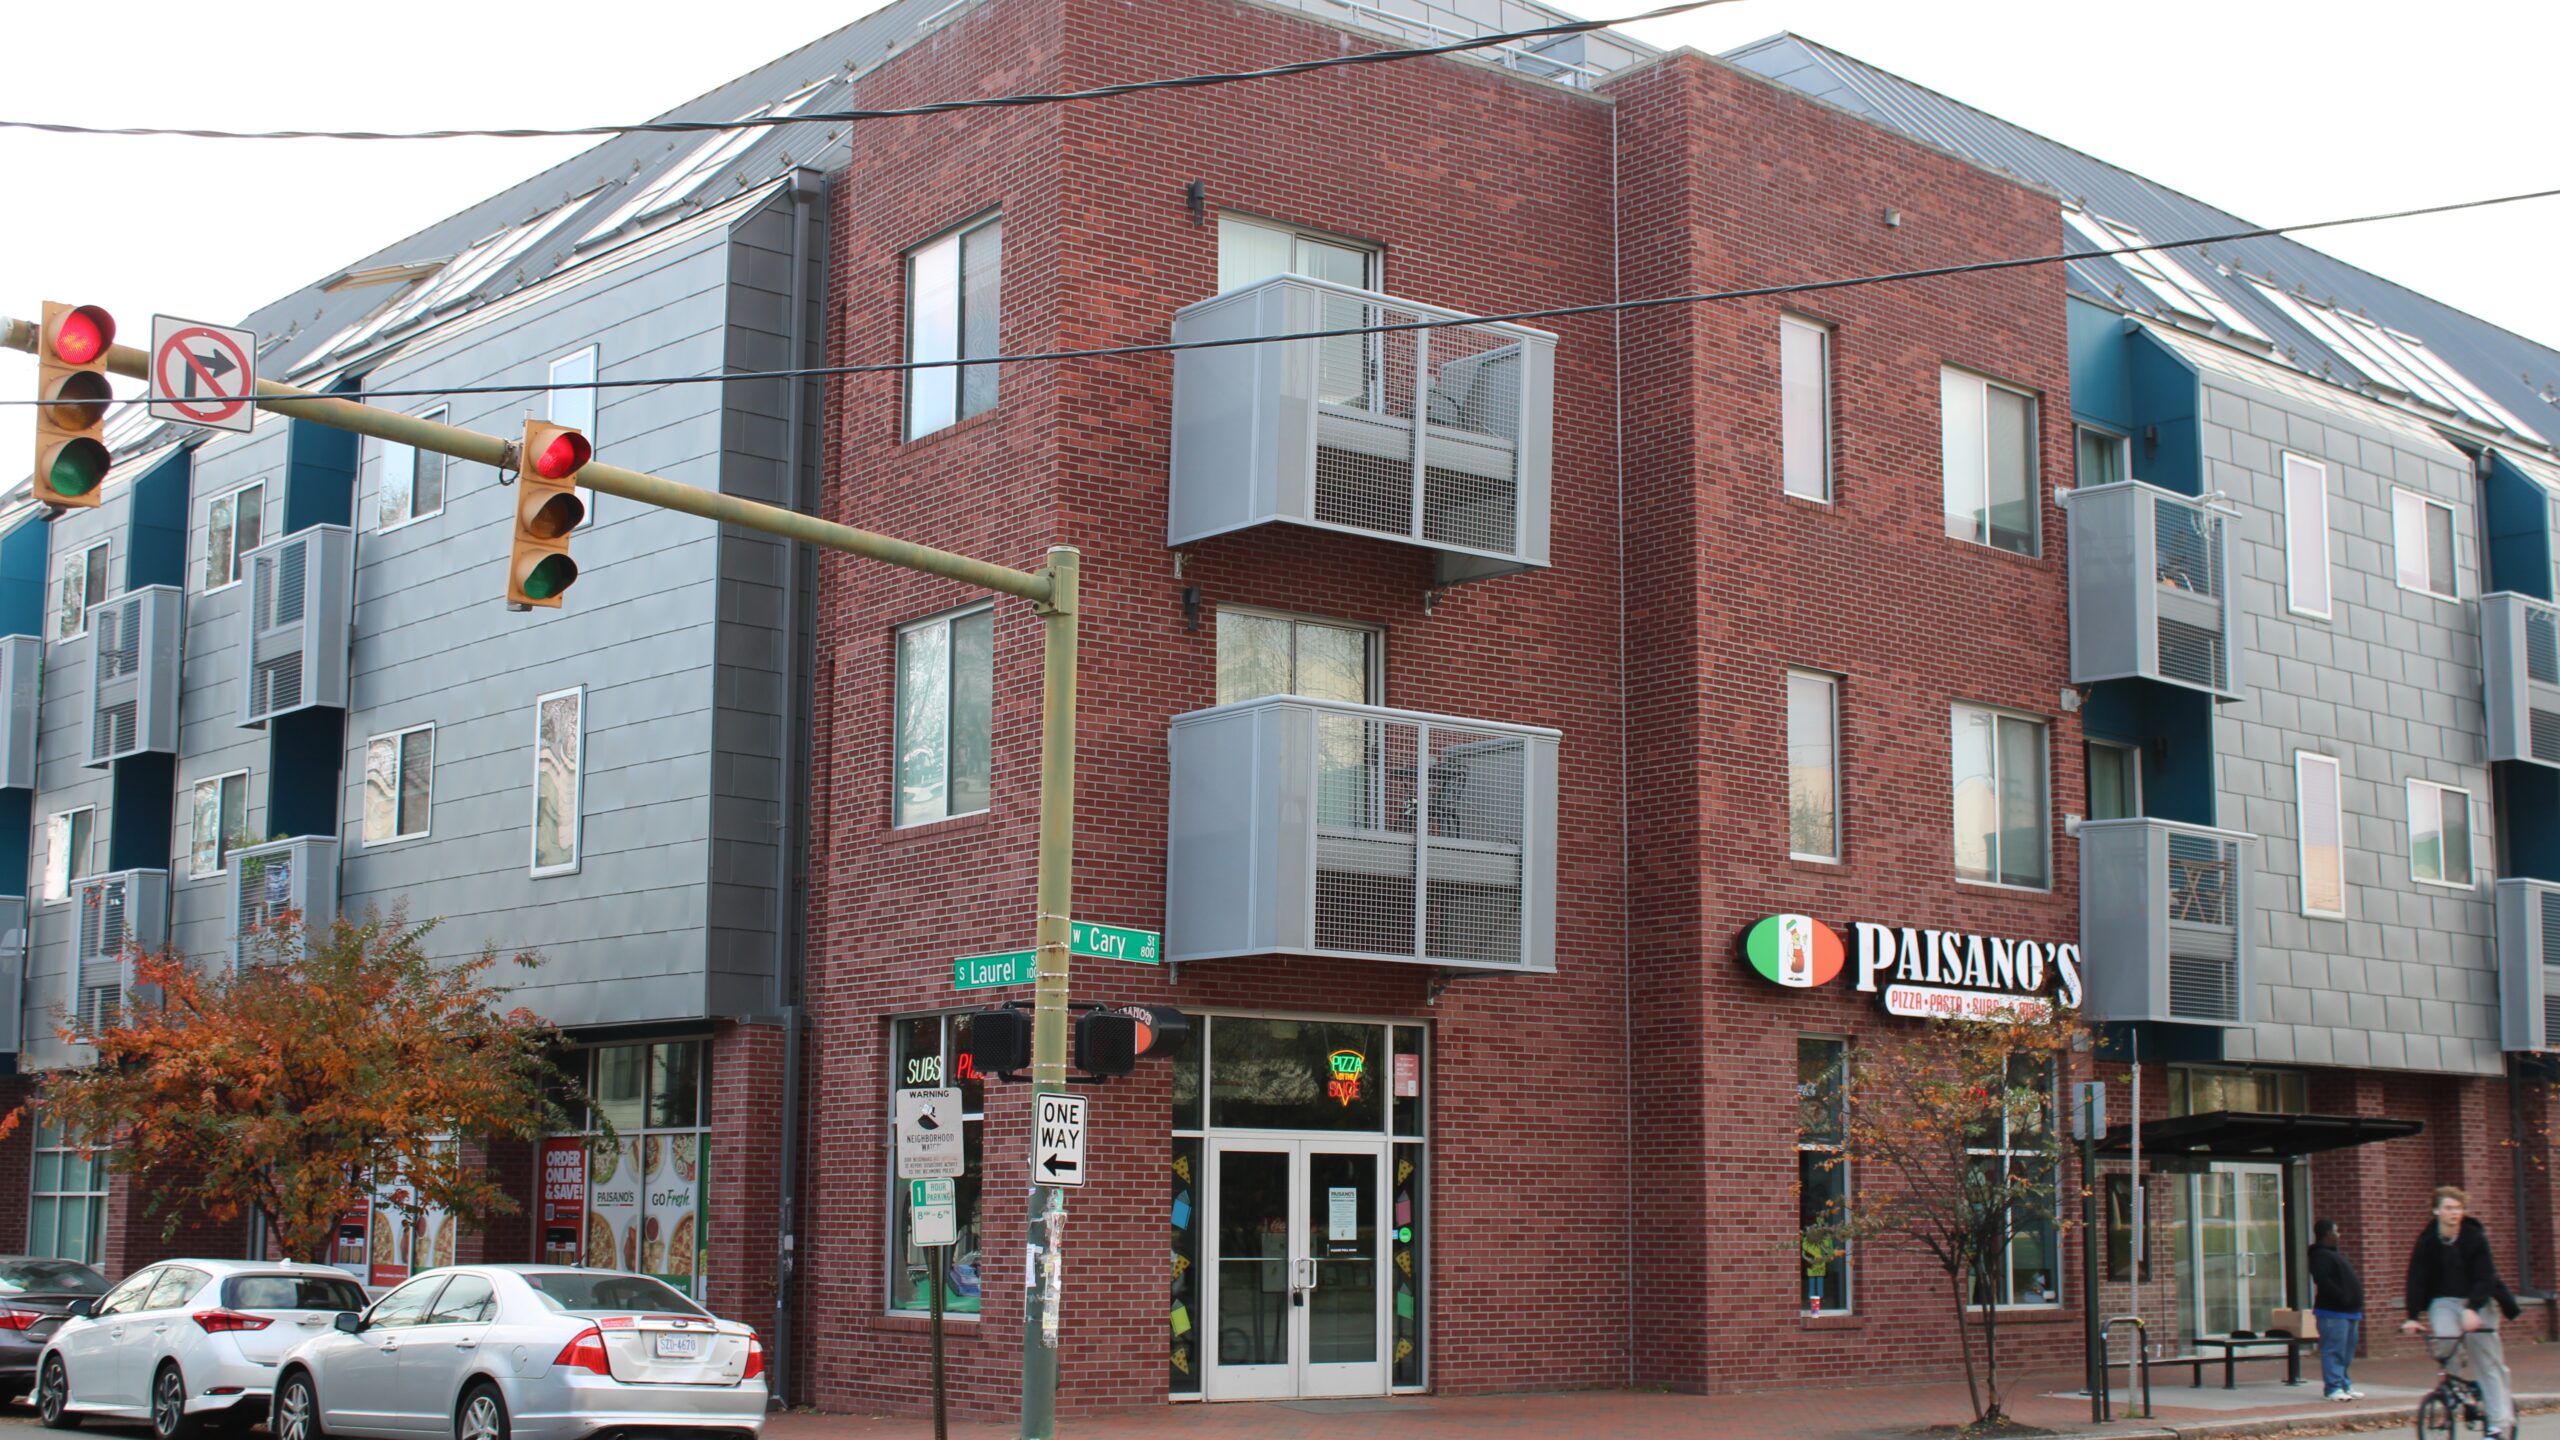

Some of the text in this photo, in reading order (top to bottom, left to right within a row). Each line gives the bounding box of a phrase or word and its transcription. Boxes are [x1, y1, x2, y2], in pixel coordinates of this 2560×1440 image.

[1073, 928, 1126, 959] W Cary
[1147, 935, 1155, 947] St
[1140, 946, 1155, 958] 800
[959, 958, 1016, 985] S Laurel
[1856, 921, 2083, 1009] PAISANO'S
[1891, 990, 1923, 1010] PIZZA
[1930, 994, 1962, 1013] PASTA
[906, 1056, 942, 1084] SUBS
[1332, 1055, 1362, 1072] PIZZA
[909, 1090, 949, 1098] WARNING
[1328, 1081, 1360, 1098] SLICE
[1044, 1102, 1079, 1124] ONE
[907, 1134, 954, 1143] NEIGHBORHOOD
[1041, 1127, 1079, 1149] WAY
[546, 1151, 580, 1167] ORDER
[546, 1167, 583, 1183] ONLINE
[545, 1184, 583, 1200] & SAVE!
[597, 1190, 634, 1203] PAISANO'S
[652, 1193, 666, 1206] GO
[917, 1183, 946, 1202] 1 HOUR
[927, 1192, 951, 1200] PARKING
